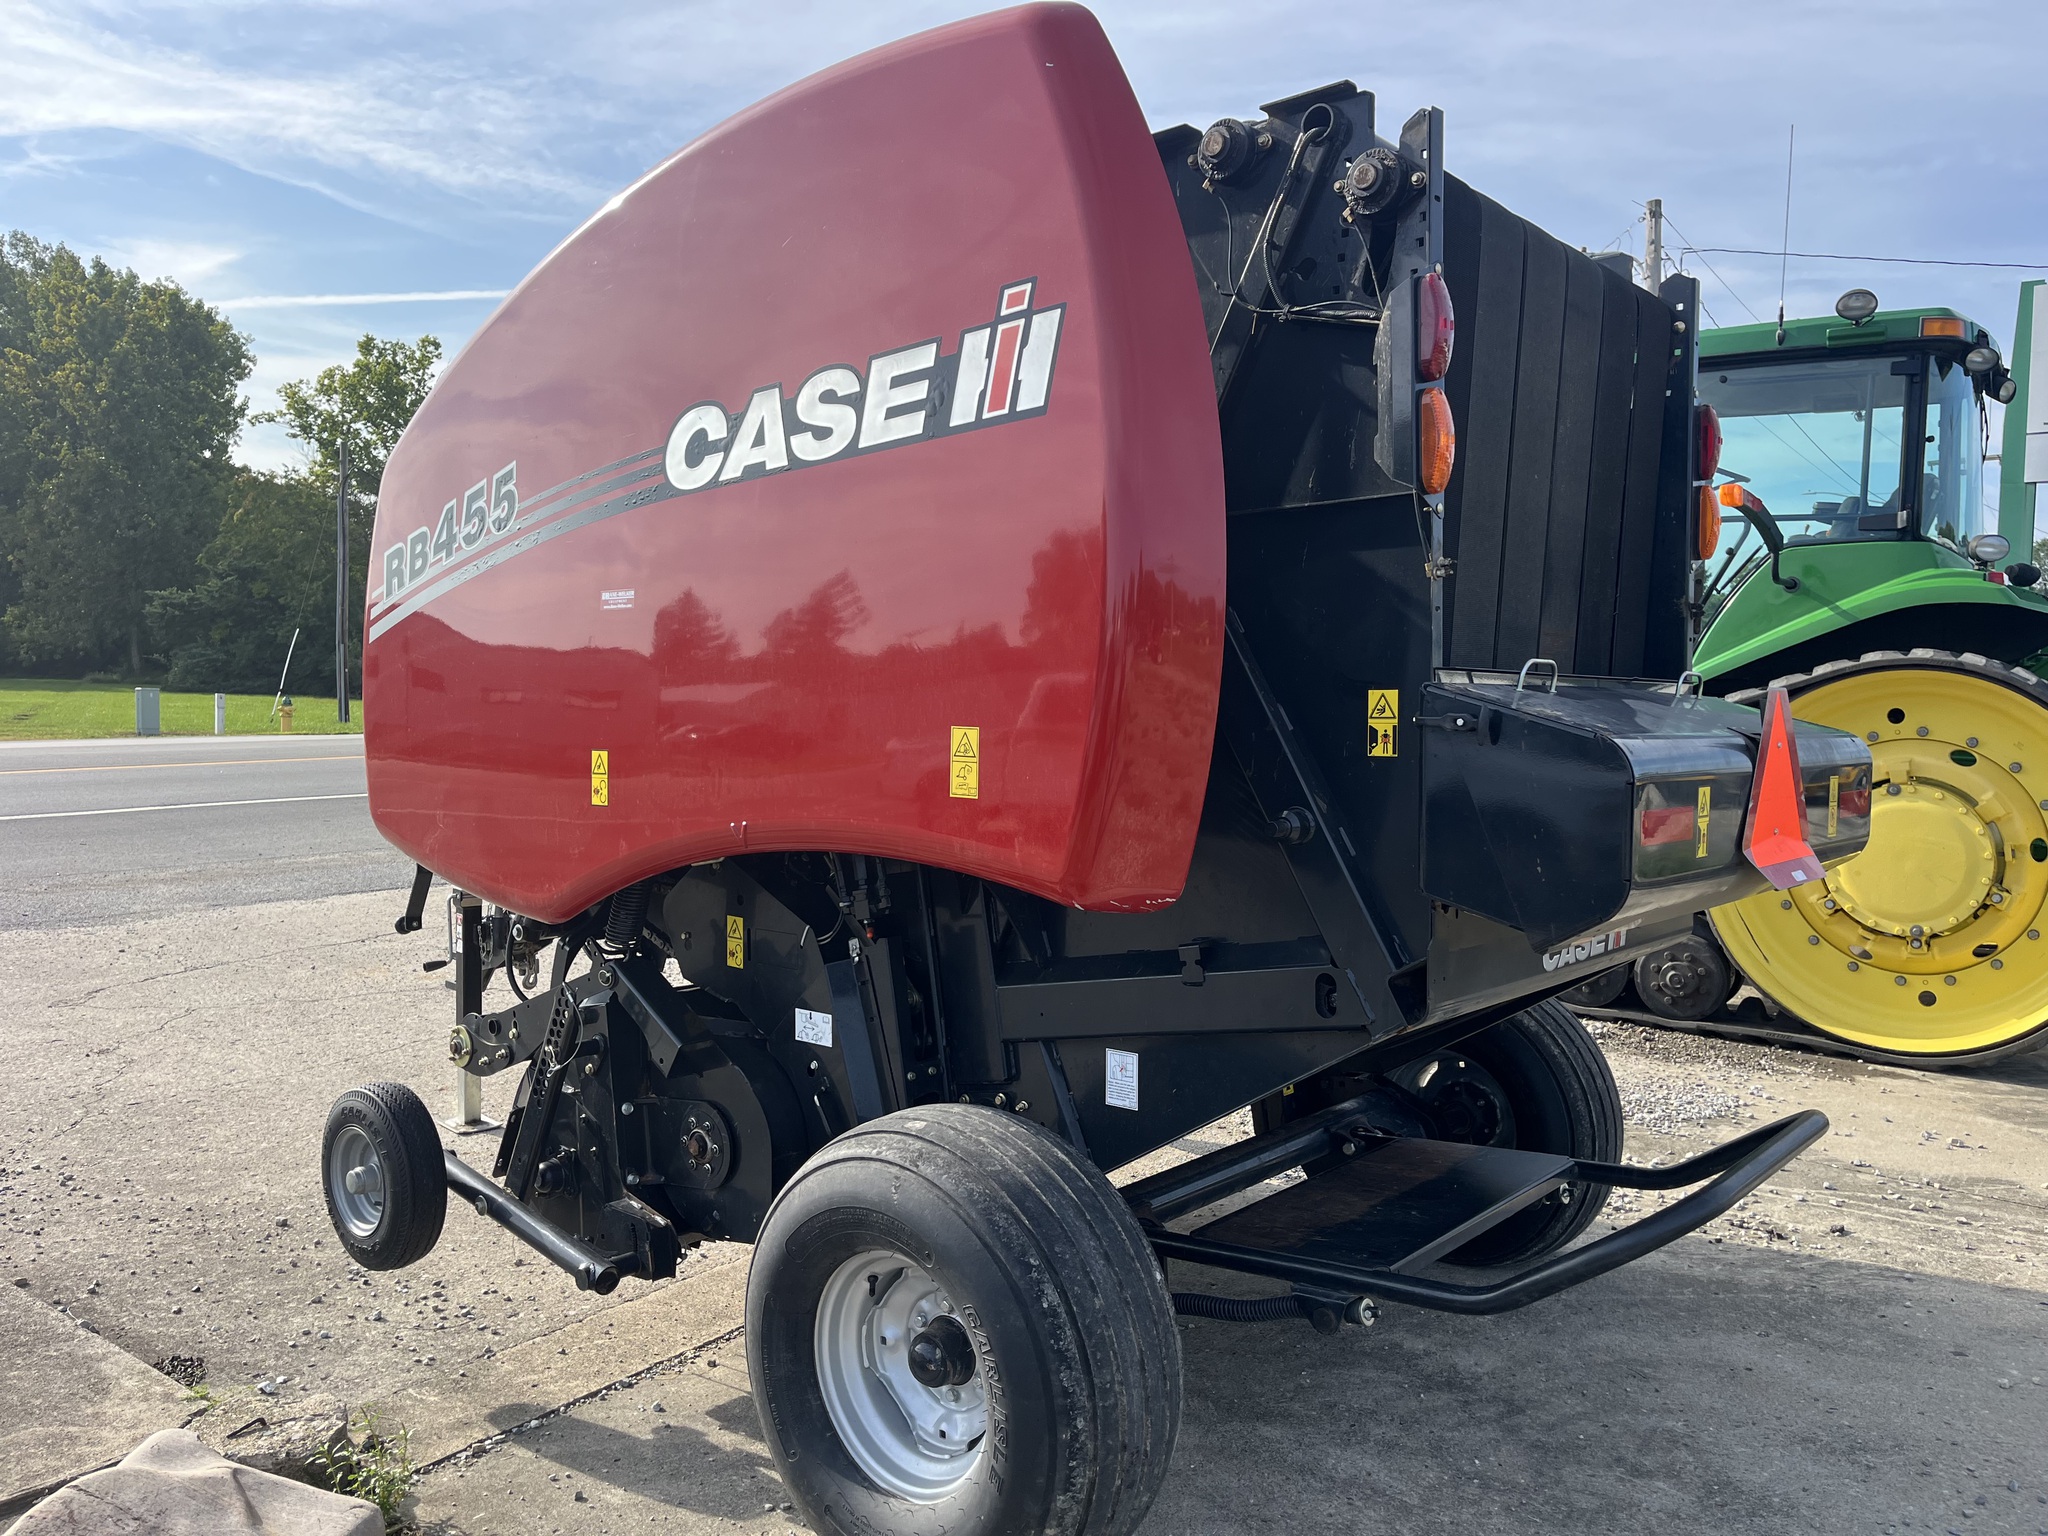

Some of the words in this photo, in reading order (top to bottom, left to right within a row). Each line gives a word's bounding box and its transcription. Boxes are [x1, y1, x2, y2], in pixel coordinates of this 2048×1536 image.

[663, 341, 940, 491] CASE
[383, 460, 518, 601] RB455
[341, 1106, 388, 1162] CARLISLE
[961, 1304, 1008, 1497] CARLISLE
